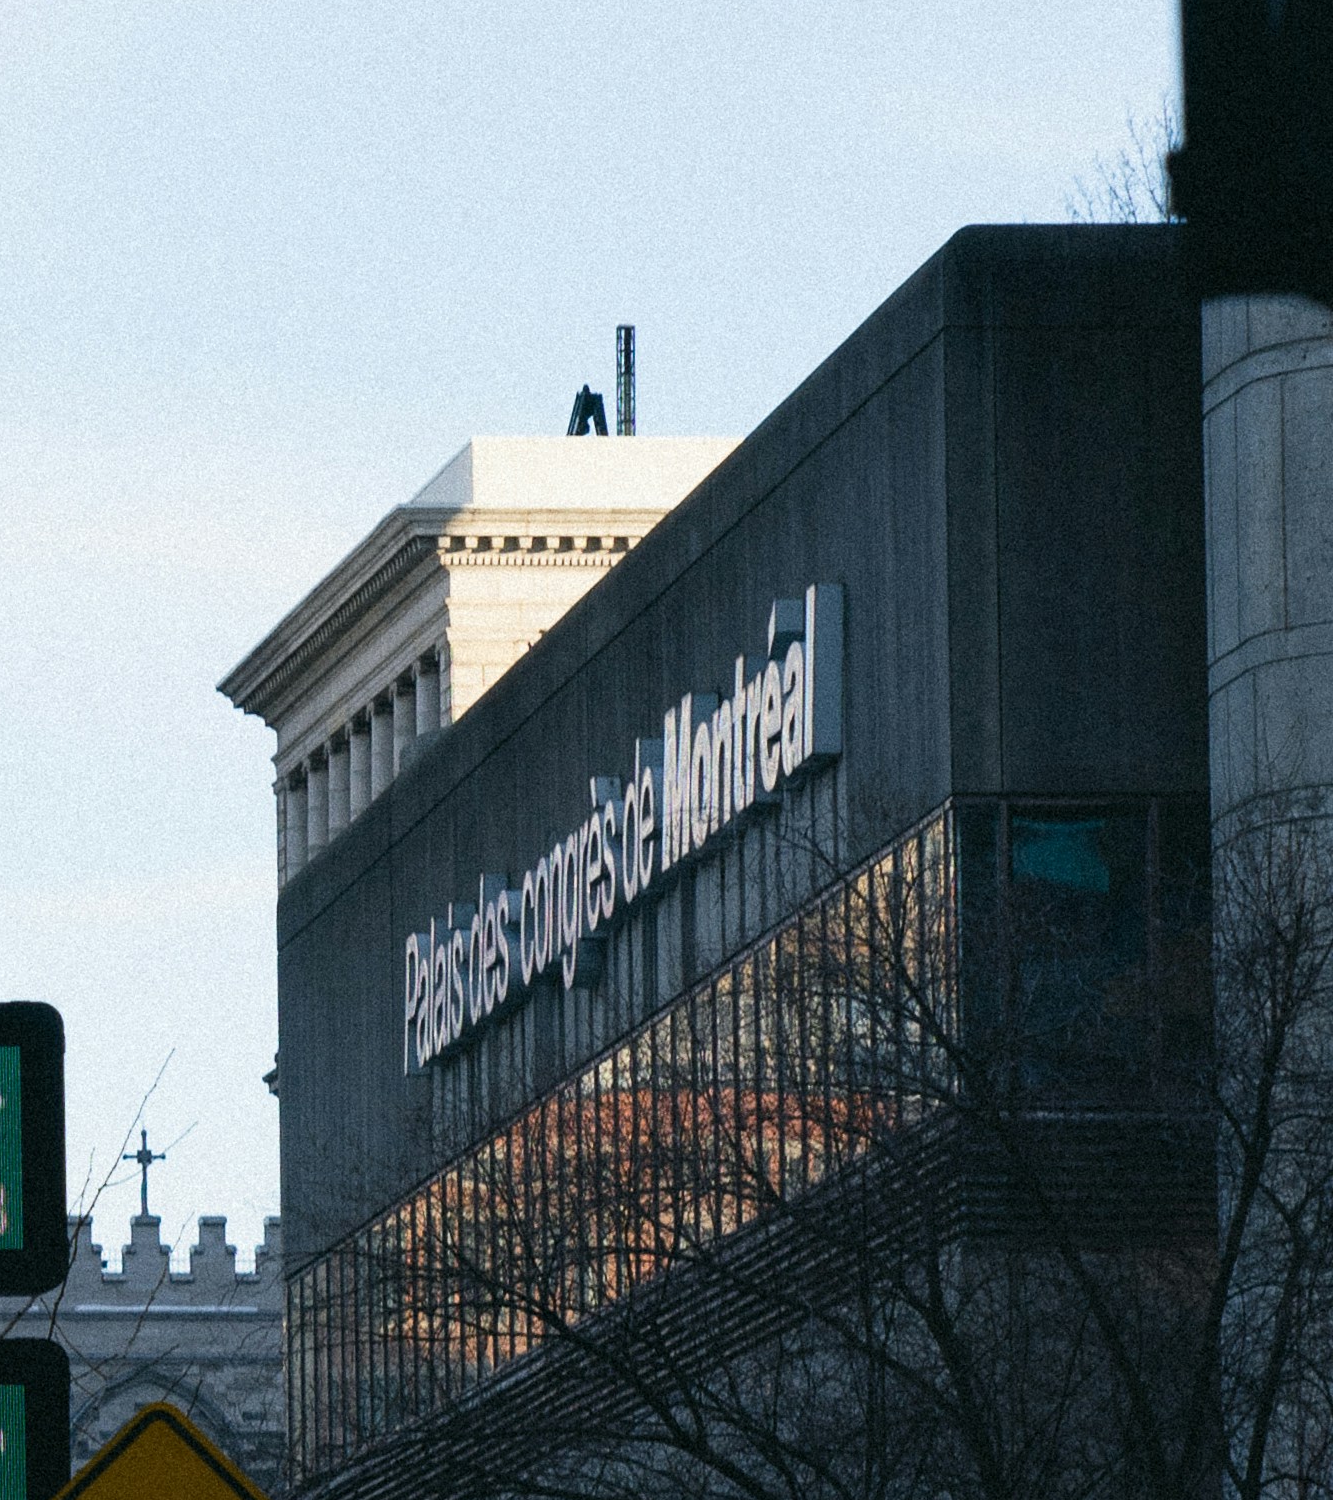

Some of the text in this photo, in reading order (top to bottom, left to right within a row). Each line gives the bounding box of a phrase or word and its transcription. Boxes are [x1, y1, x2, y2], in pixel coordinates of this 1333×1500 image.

[404, 583, 817, 1076] Palais des congrès de Montréal
